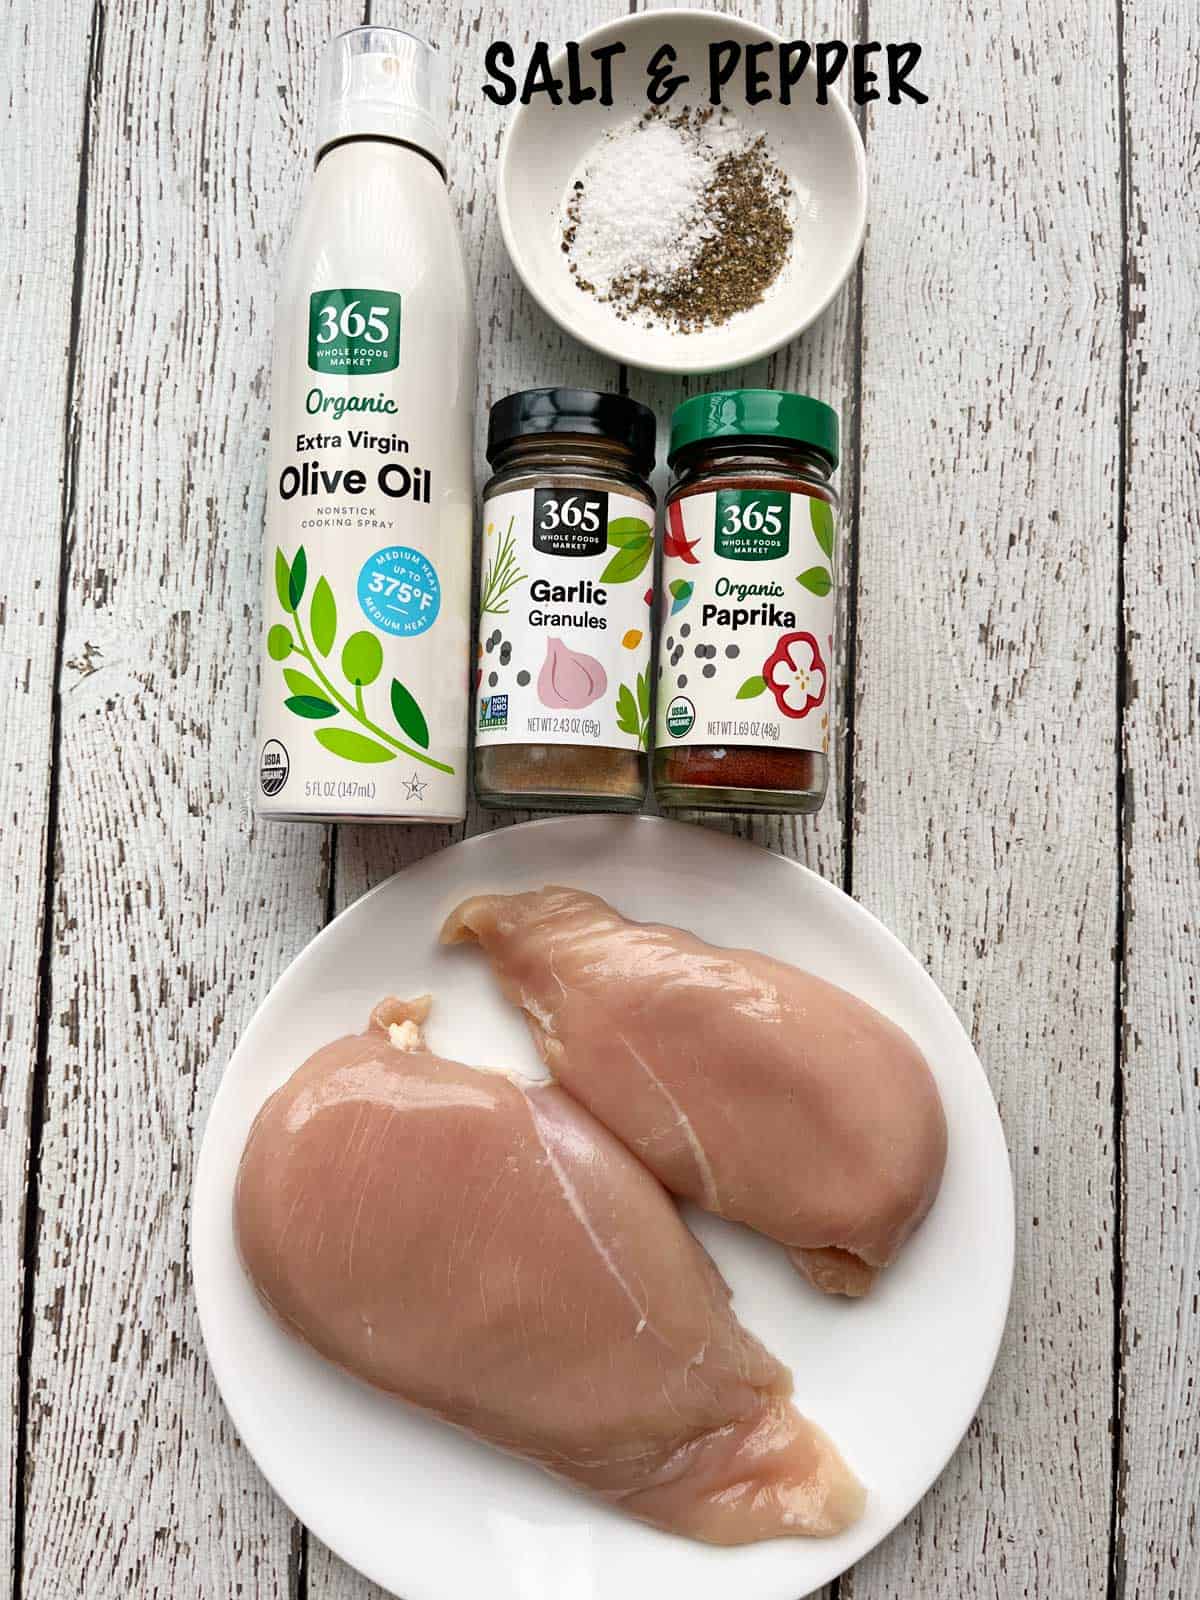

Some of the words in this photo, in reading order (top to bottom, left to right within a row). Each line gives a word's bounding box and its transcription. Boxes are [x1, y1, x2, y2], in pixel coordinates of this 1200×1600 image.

[316, 300, 389, 344] 365
[317, 348, 350, 357] WHOLE
[354, 348, 389, 358] FOODS
[330, 359, 372, 367] MARKET
[306, 388, 398, 420] Organic
[296, 433, 341, 452] Extra
[347, 430, 409, 454] Virgin
[279, 461, 366, 500] Olive
[377, 463, 432, 504] Oil
[317, 506, 376, 516] NONSTICK
[539, 496, 601, 532] 365
[721, 500, 784, 536] 365
[301, 518, 352, 528] COOKING
[357, 519, 394, 528] SPRAY
[540, 534, 569, 542] WHOLE
[572, 535, 600, 544] FOODS
[552, 542, 587, 550] MARKET
[721, 539, 750, 547] WHOLE
[753, 539, 781, 547] FOODS
[376, 551, 420, 565] MEDIUM
[421, 563, 437, 592] HEAT
[393, 565, 406, 575] UP
[408, 570, 421, 582] TO
[530, 579, 607, 605] Garlic
[715, 577, 785, 601] Organic
[364, 596, 400, 631] MEDIUM
[404, 615, 428, 631] HEAT
[529, 610, 607, 630] Granules
[702, 603, 796, 631] Paprika
[671, 706, 689, 716] USDA
[527, 717, 540, 732] NET
[541, 717, 552, 732] WT
[571, 718, 580, 733] OZ
[707, 721, 719, 736] NET
[721, 721, 732, 736] WT
[733, 721, 749, 736] 1.69
[750, 722, 760, 736] OZ
[761, 722, 781, 740] (48g)
[264, 753, 280, 765] USDA
[304, 781, 311, 796] 5
[312, 781, 321, 797] FL
[323, 781, 336, 797] OZ
